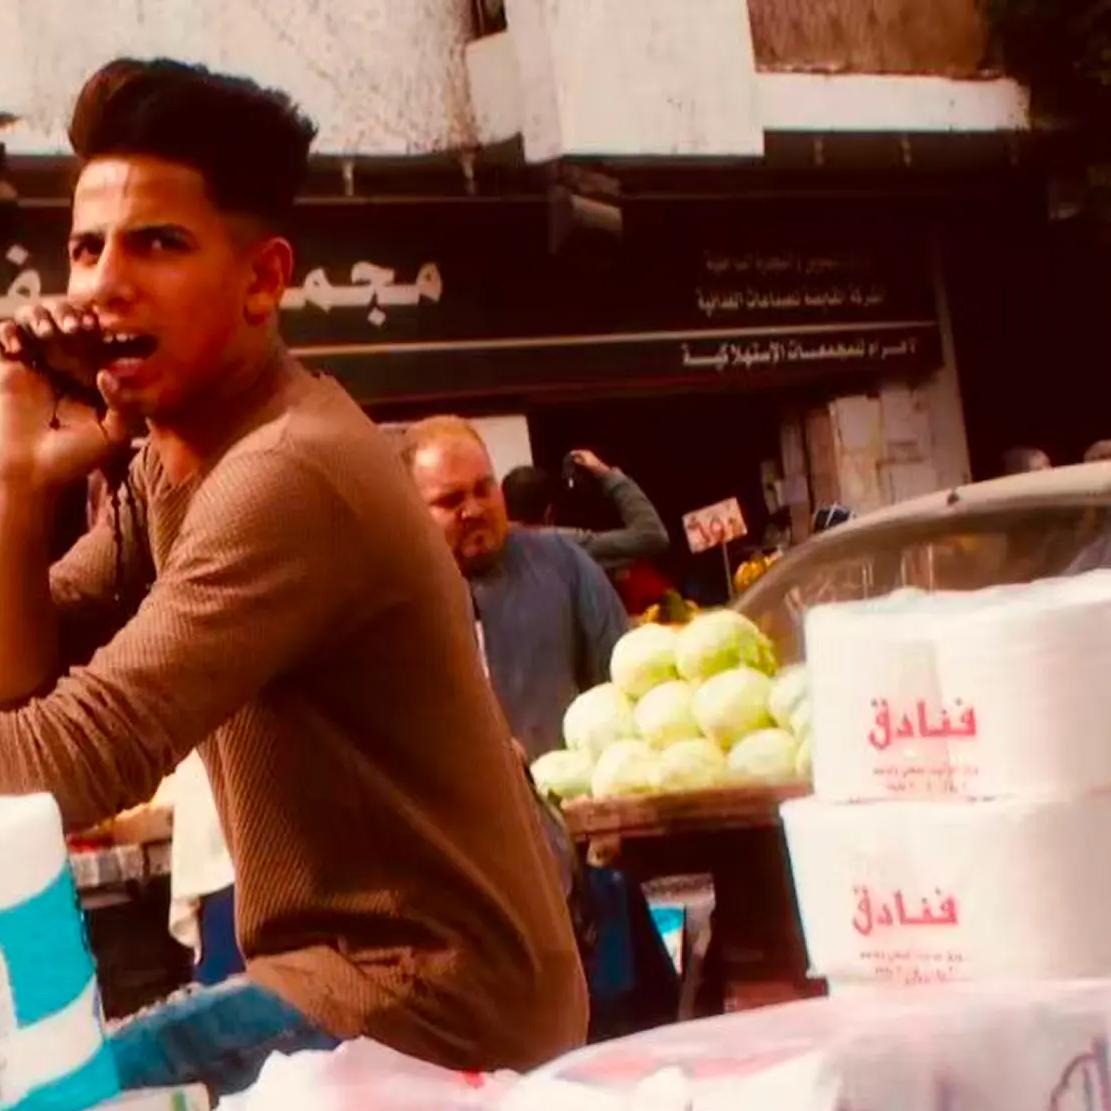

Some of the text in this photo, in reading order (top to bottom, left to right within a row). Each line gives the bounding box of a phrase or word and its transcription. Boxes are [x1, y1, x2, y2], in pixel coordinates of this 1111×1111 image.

[279, 260, 442, 328] مجم
[868, 697, 978, 751] فنادق
[852, 885, 959, 937] فنادق
